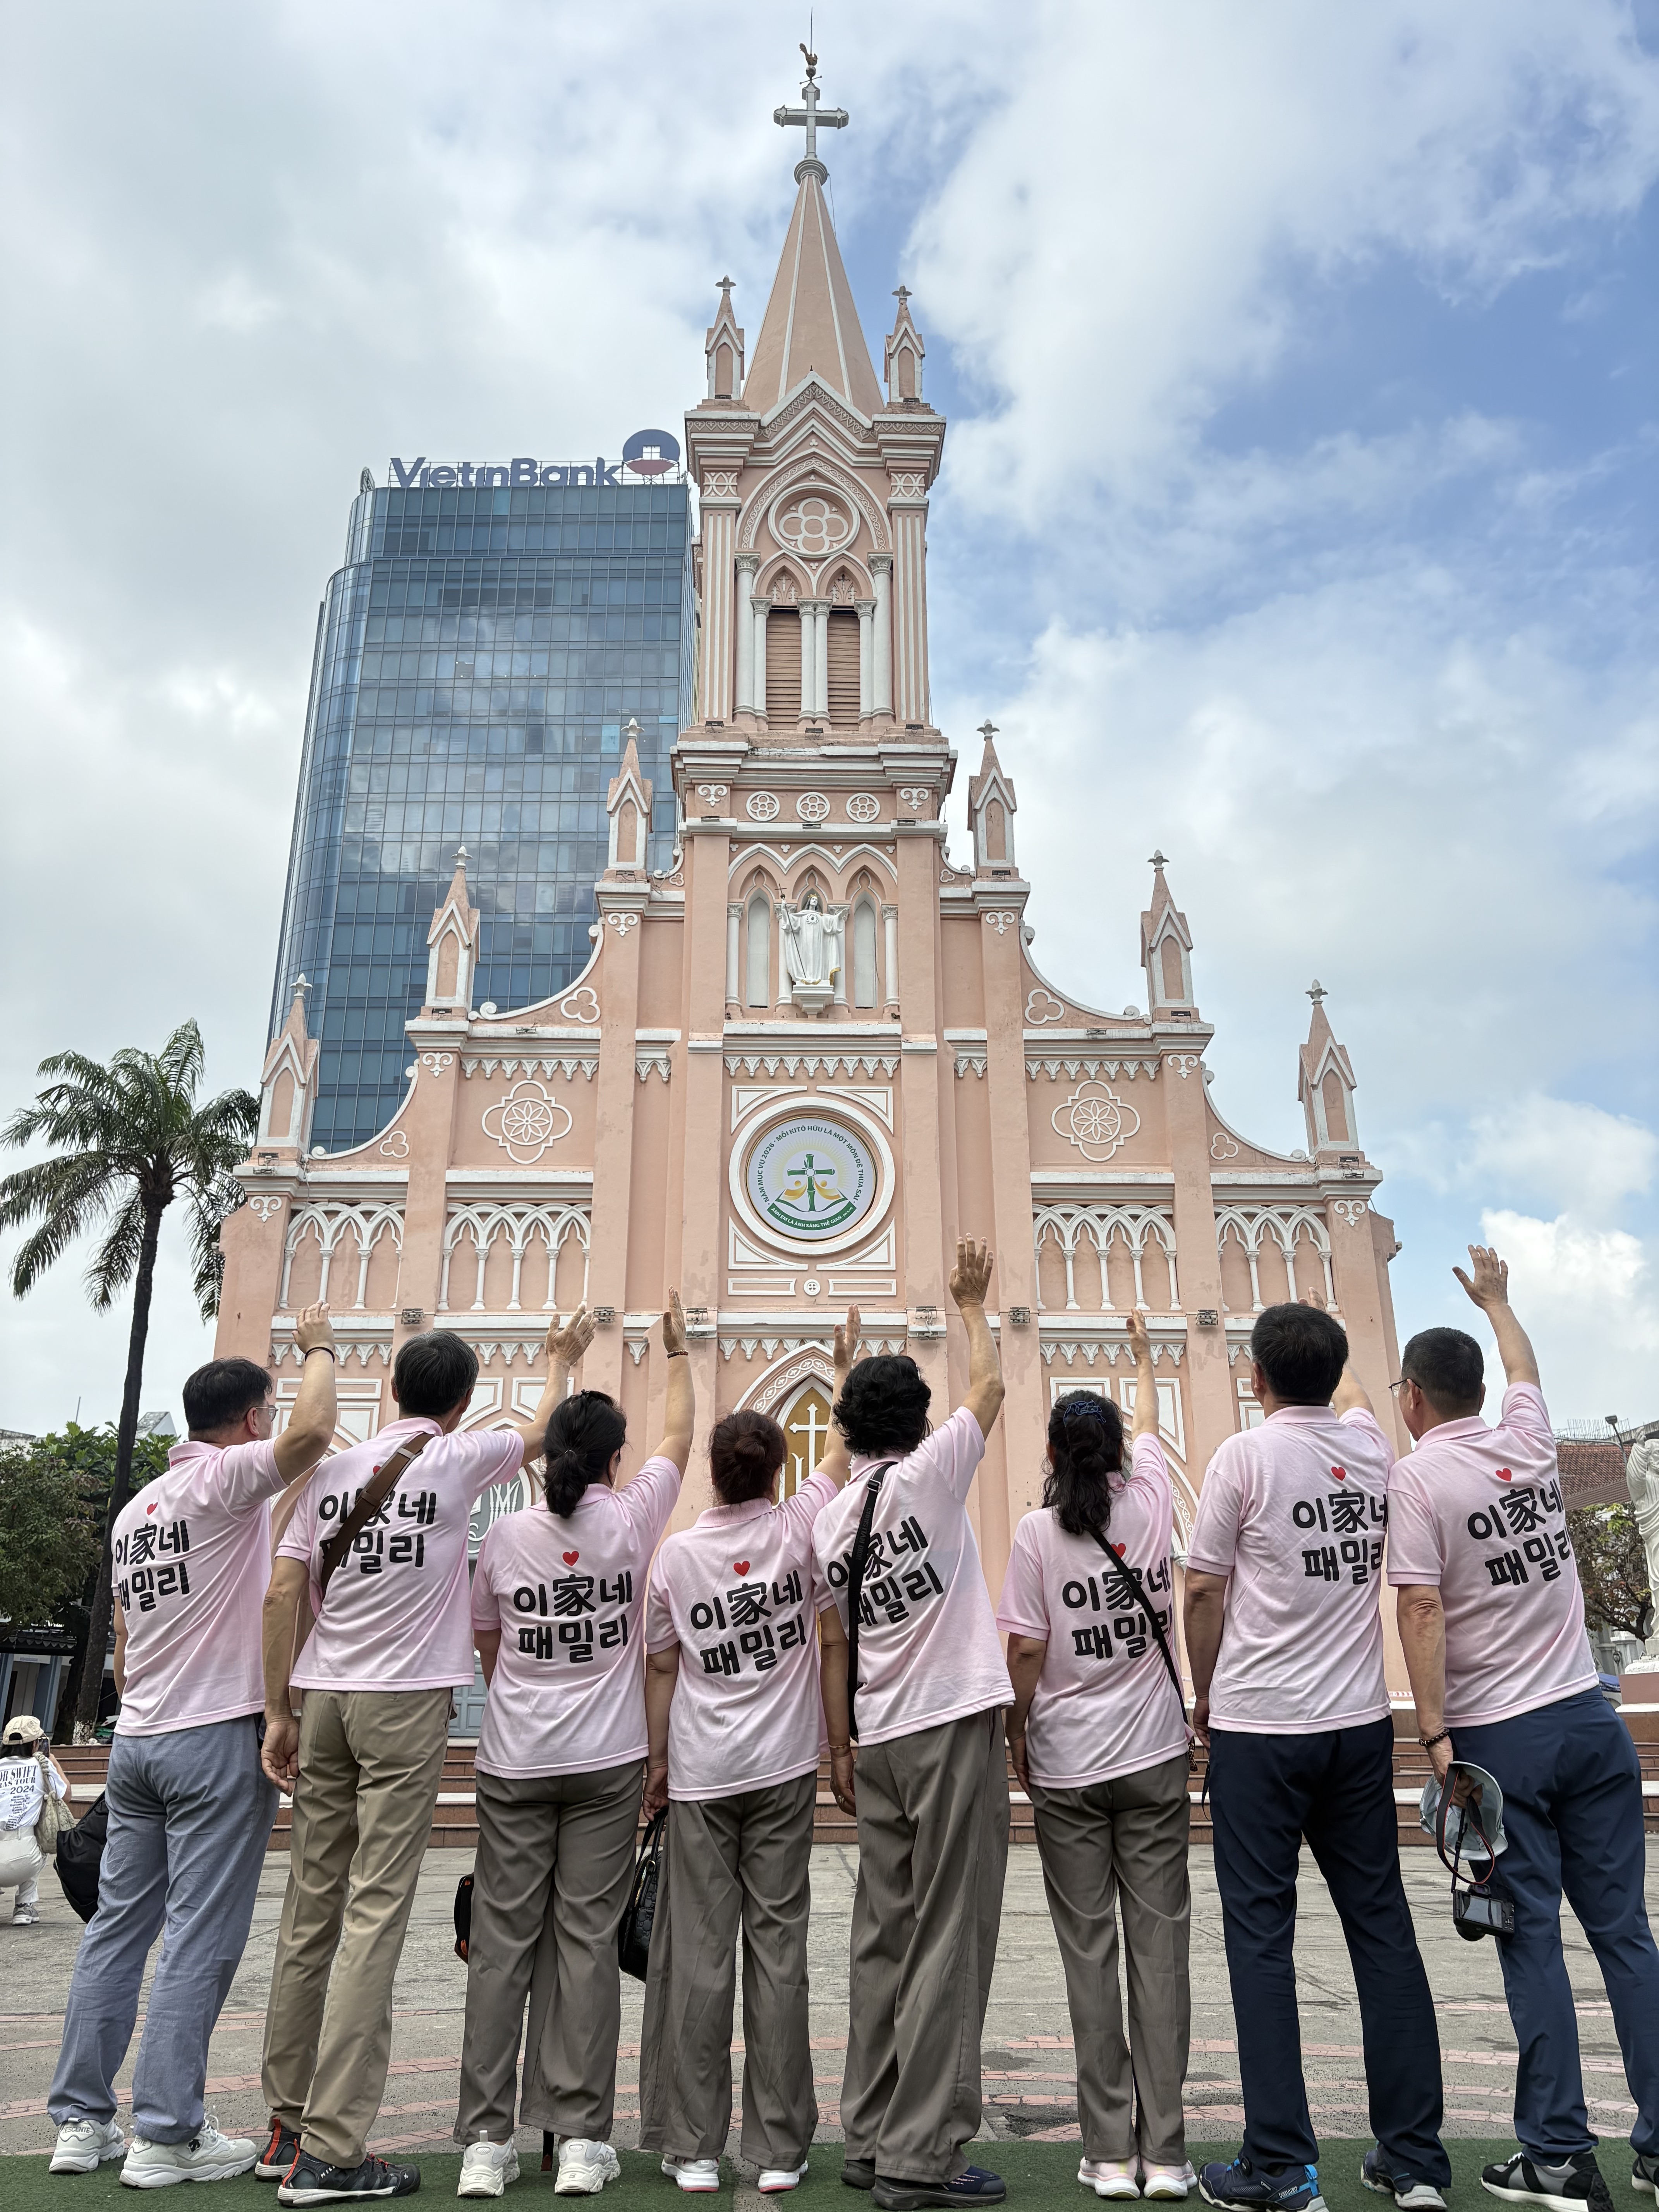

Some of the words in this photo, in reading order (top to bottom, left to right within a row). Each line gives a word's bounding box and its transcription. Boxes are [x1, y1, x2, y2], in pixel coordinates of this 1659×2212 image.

[390, 457, 623, 488] VietinBank
[763, 1142, 775, 1159] 2026
[789, 1125, 806, 1135] KITÔ
[853, 1189, 862, 1201] SAI
[771, 1207, 781, 1217] ANH
[830, 1215, 842, 1224] GIAN
[859, 1508, 872, 1544] CHRISTIAN
[1468, 1478, 1563, 1540] 이家네
[116, 1520, 190, 1565] 이家네
[855, 1544, 864, 1561] DIOR
[514, 1571, 632, 1616] 이家네
[690, 1570, 803, 1630] 이家네
[518, 1614, 628, 1663] 패밀리
[700, 1614, 807, 1676] 패밀리
[10, 1765, 38, 1780] SWIFT
[10, 1785, 34, 1794] 2024
[15, 1777, 35, 1785] TOUR
